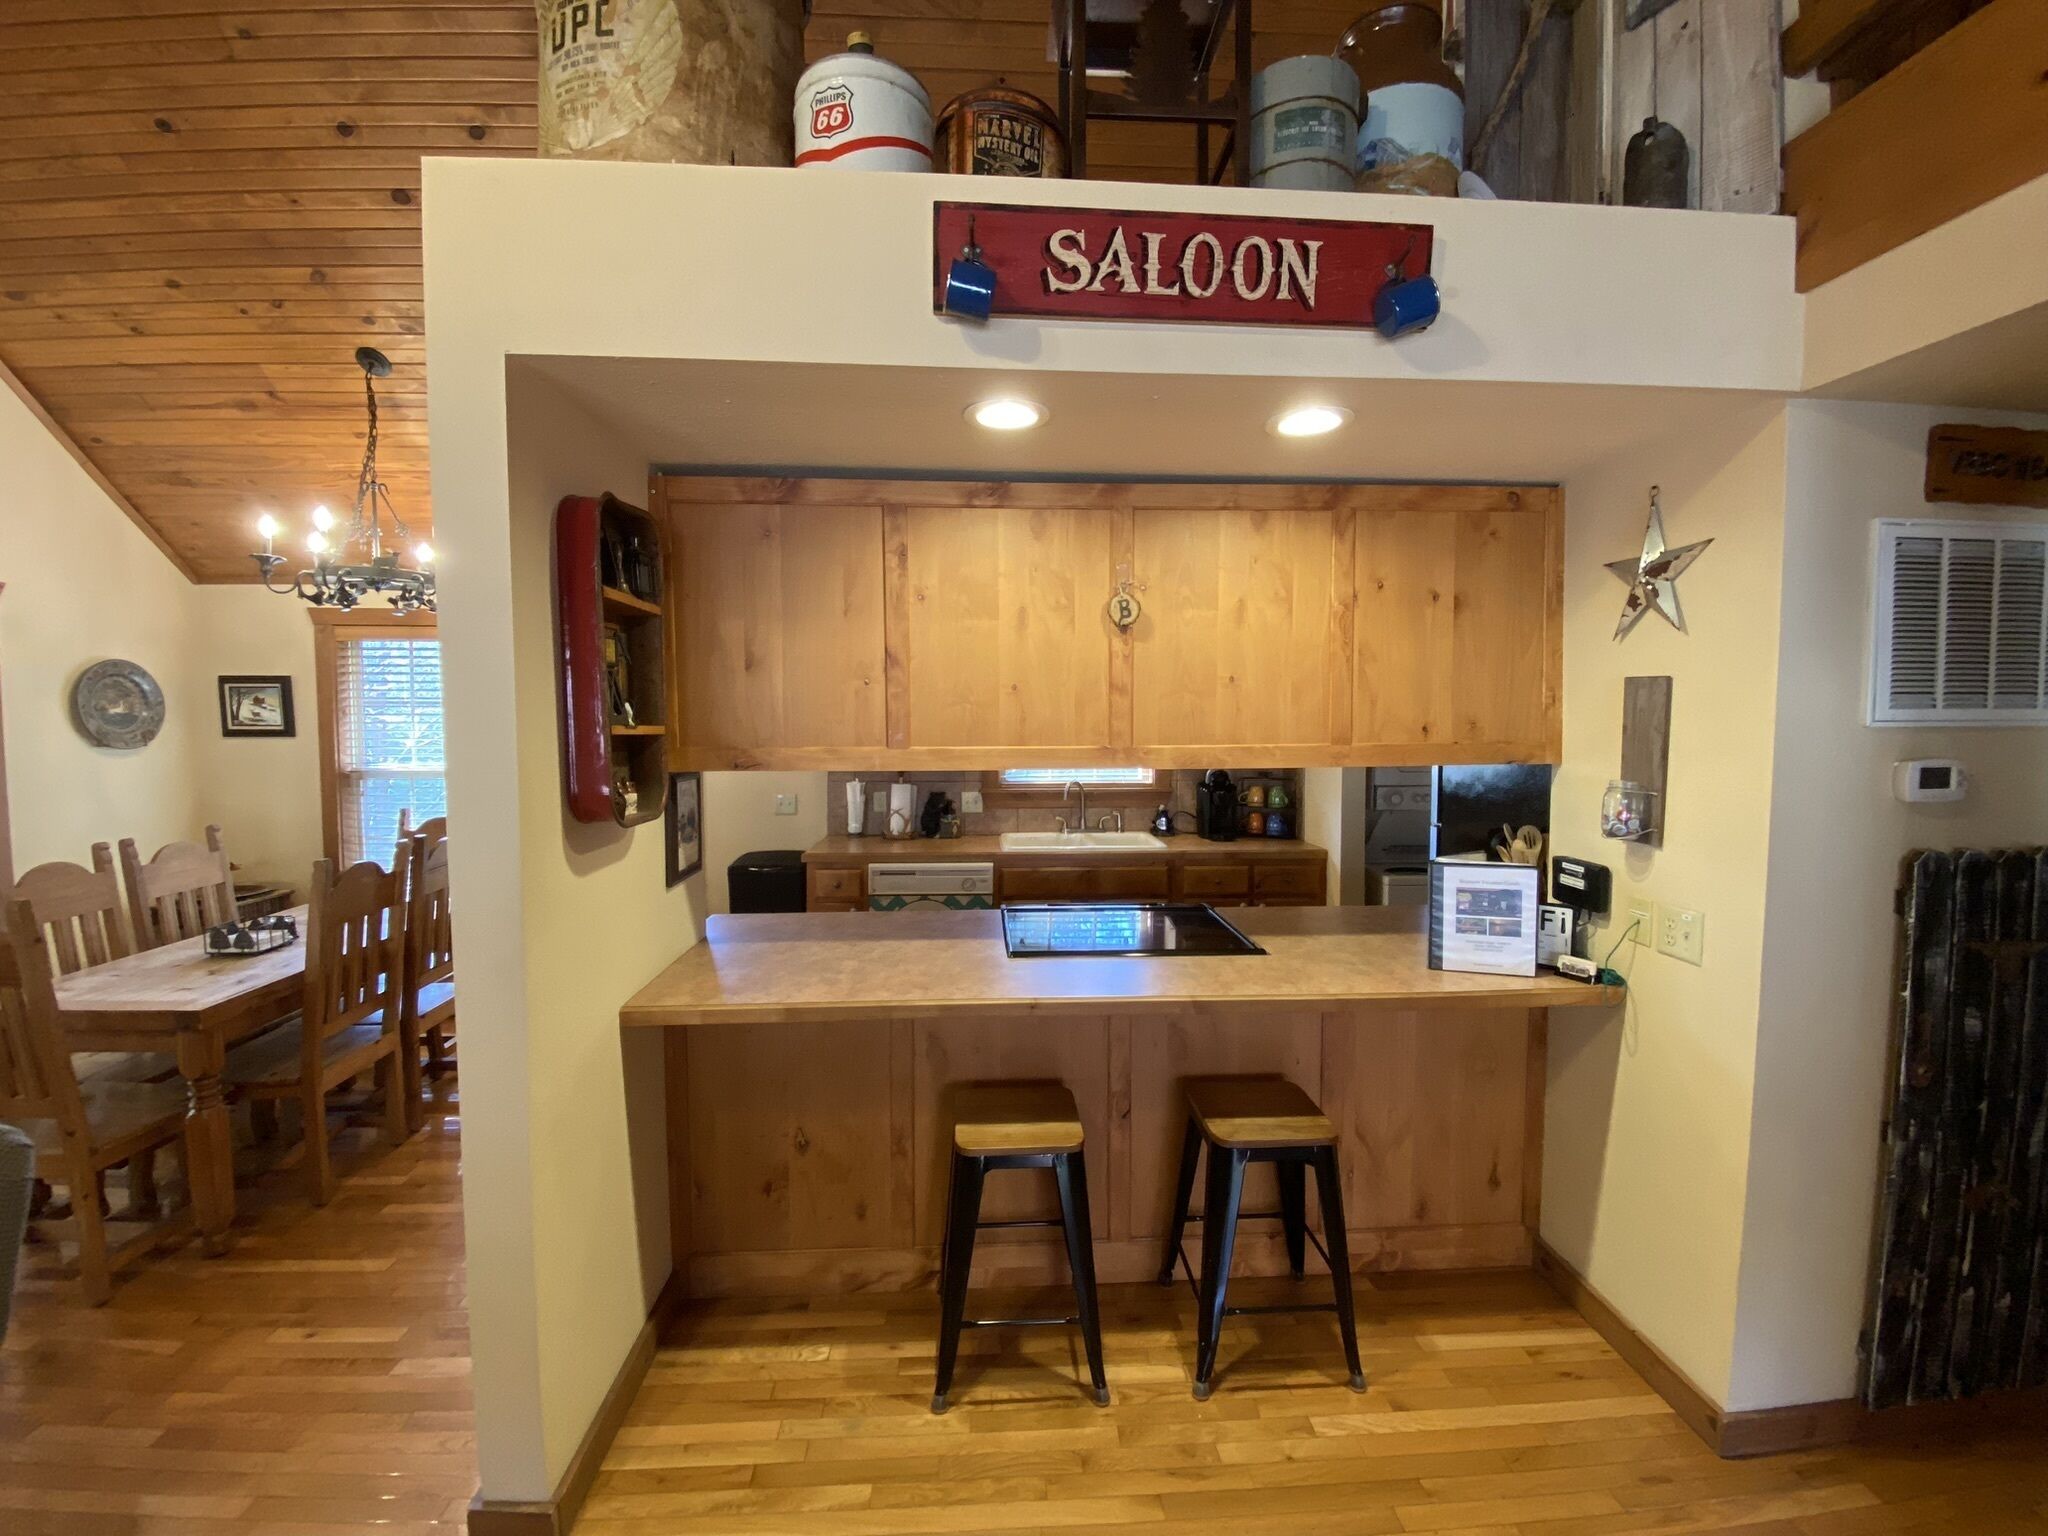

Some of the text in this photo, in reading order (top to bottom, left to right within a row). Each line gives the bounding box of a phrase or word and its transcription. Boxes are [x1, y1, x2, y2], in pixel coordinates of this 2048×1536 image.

[815, 92, 847, 108] PHILLIPS
[817, 106, 844, 130] 66
[977, 118, 1040, 149] MARVEL
[977, 136, 1022, 157] MYSTERY
[1024, 146, 1039, 163] OIL
[1046, 226, 1323, 310] SALOON
[1118, 599, 1132, 619] B
[1540, 910, 1566, 934] Fi
